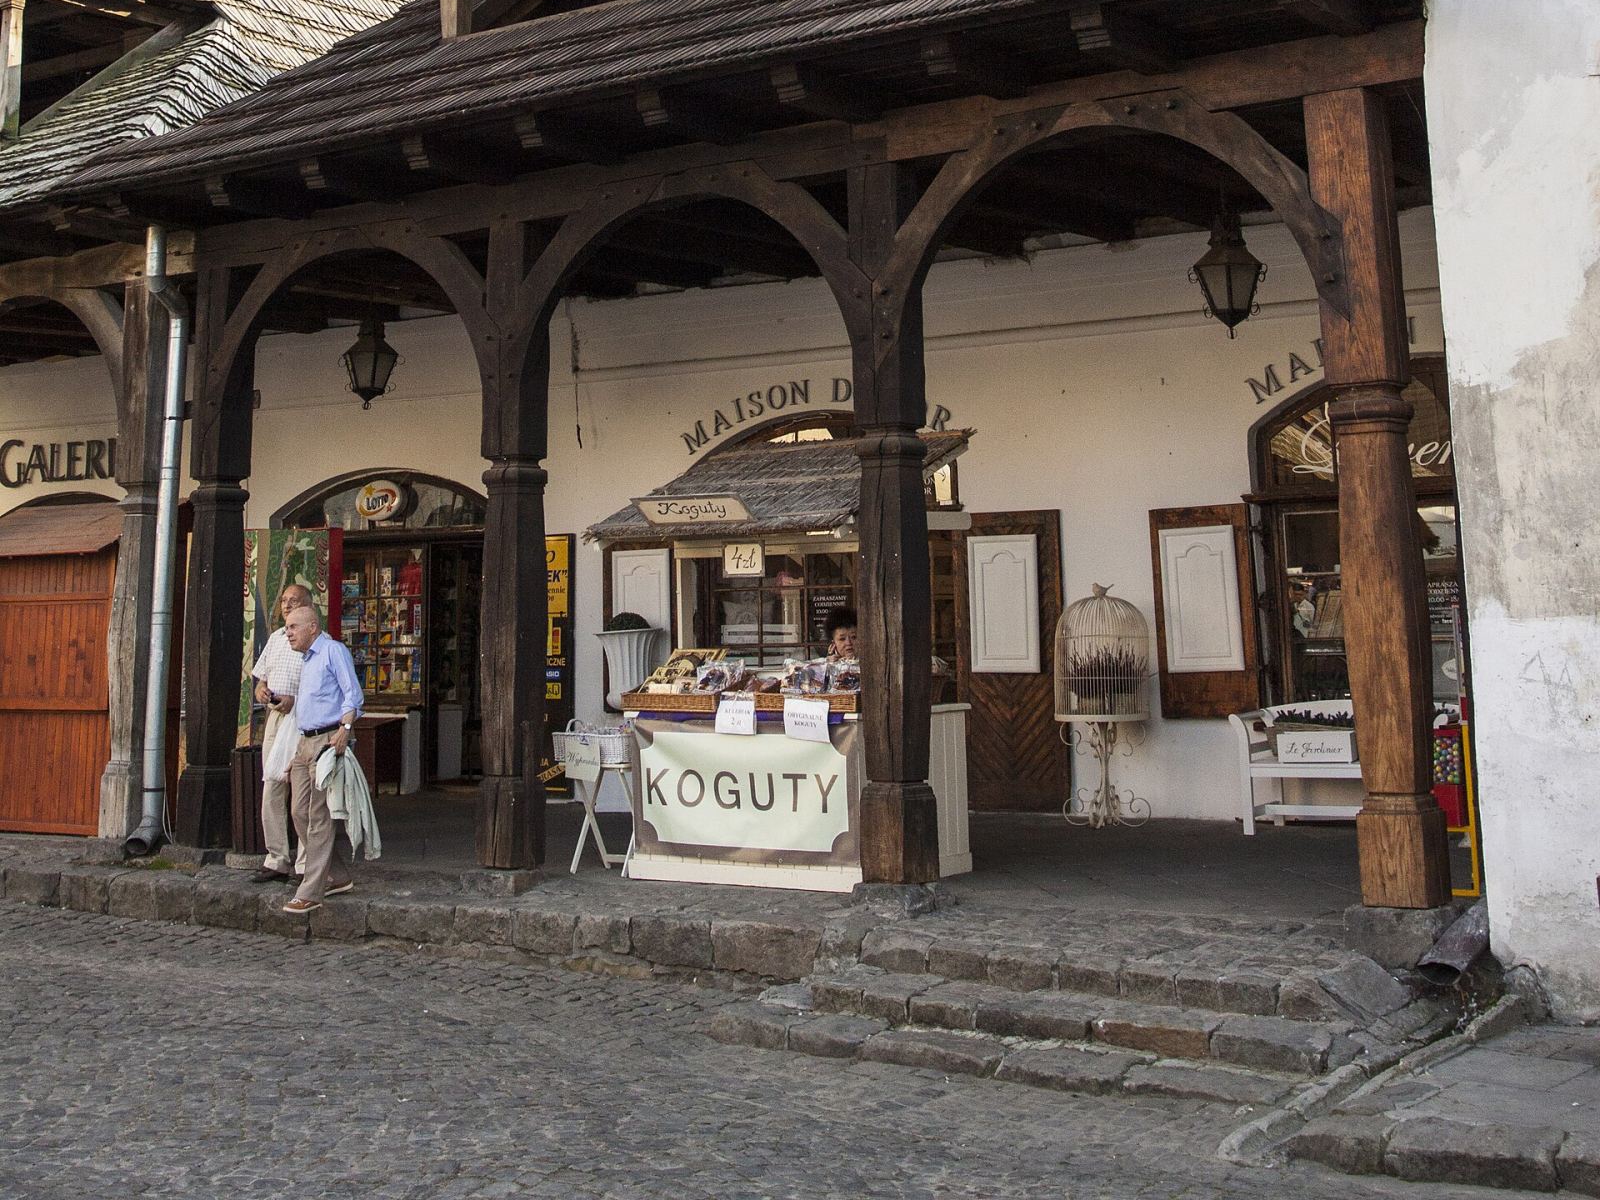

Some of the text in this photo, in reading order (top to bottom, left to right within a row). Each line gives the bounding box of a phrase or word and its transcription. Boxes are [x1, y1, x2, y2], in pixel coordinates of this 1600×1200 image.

[680, 379, 810, 455] MAISON
[0, 439, 116, 488] GALERI
[365, 493, 389, 511] LOTTO
[657, 501, 727, 520] Koguty
[794, 720, 817, 729] KOGUTY
[646, 767, 839, 814] KOGUTY
